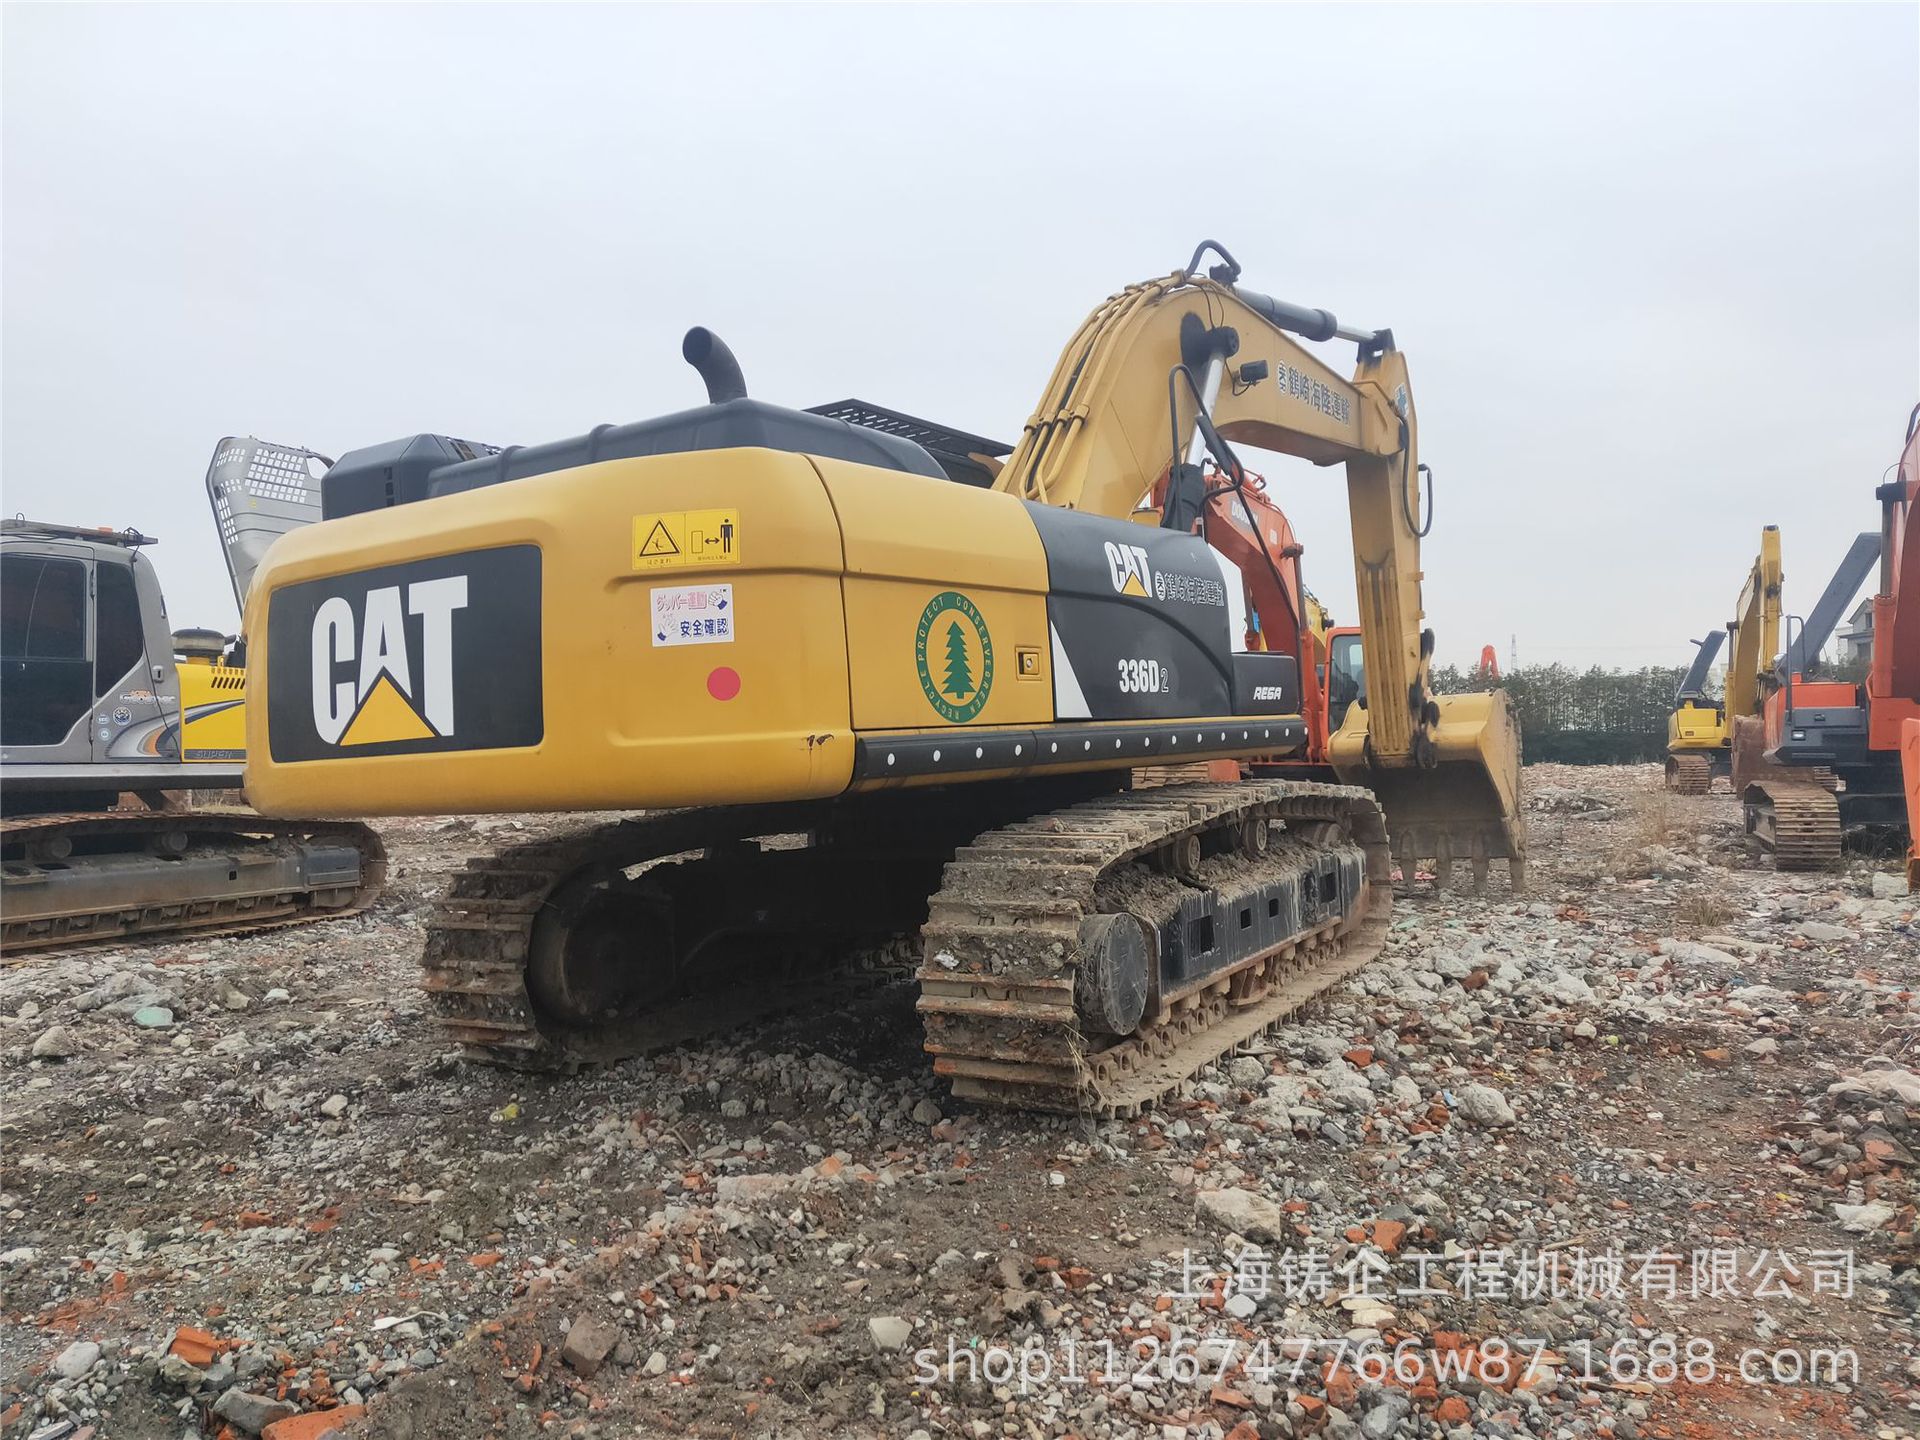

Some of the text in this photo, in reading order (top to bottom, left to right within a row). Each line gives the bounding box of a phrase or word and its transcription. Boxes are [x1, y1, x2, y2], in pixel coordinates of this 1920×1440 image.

[1104, 541, 1153, 598] CAT
[680, 618, 729, 637] 安全確認
[917, 596, 945, 662] PROTECT
[311, 574, 468, 745] CAT
[920, 670, 960, 720] RECYCLE
[1253, 686, 1282, 700] REGA
